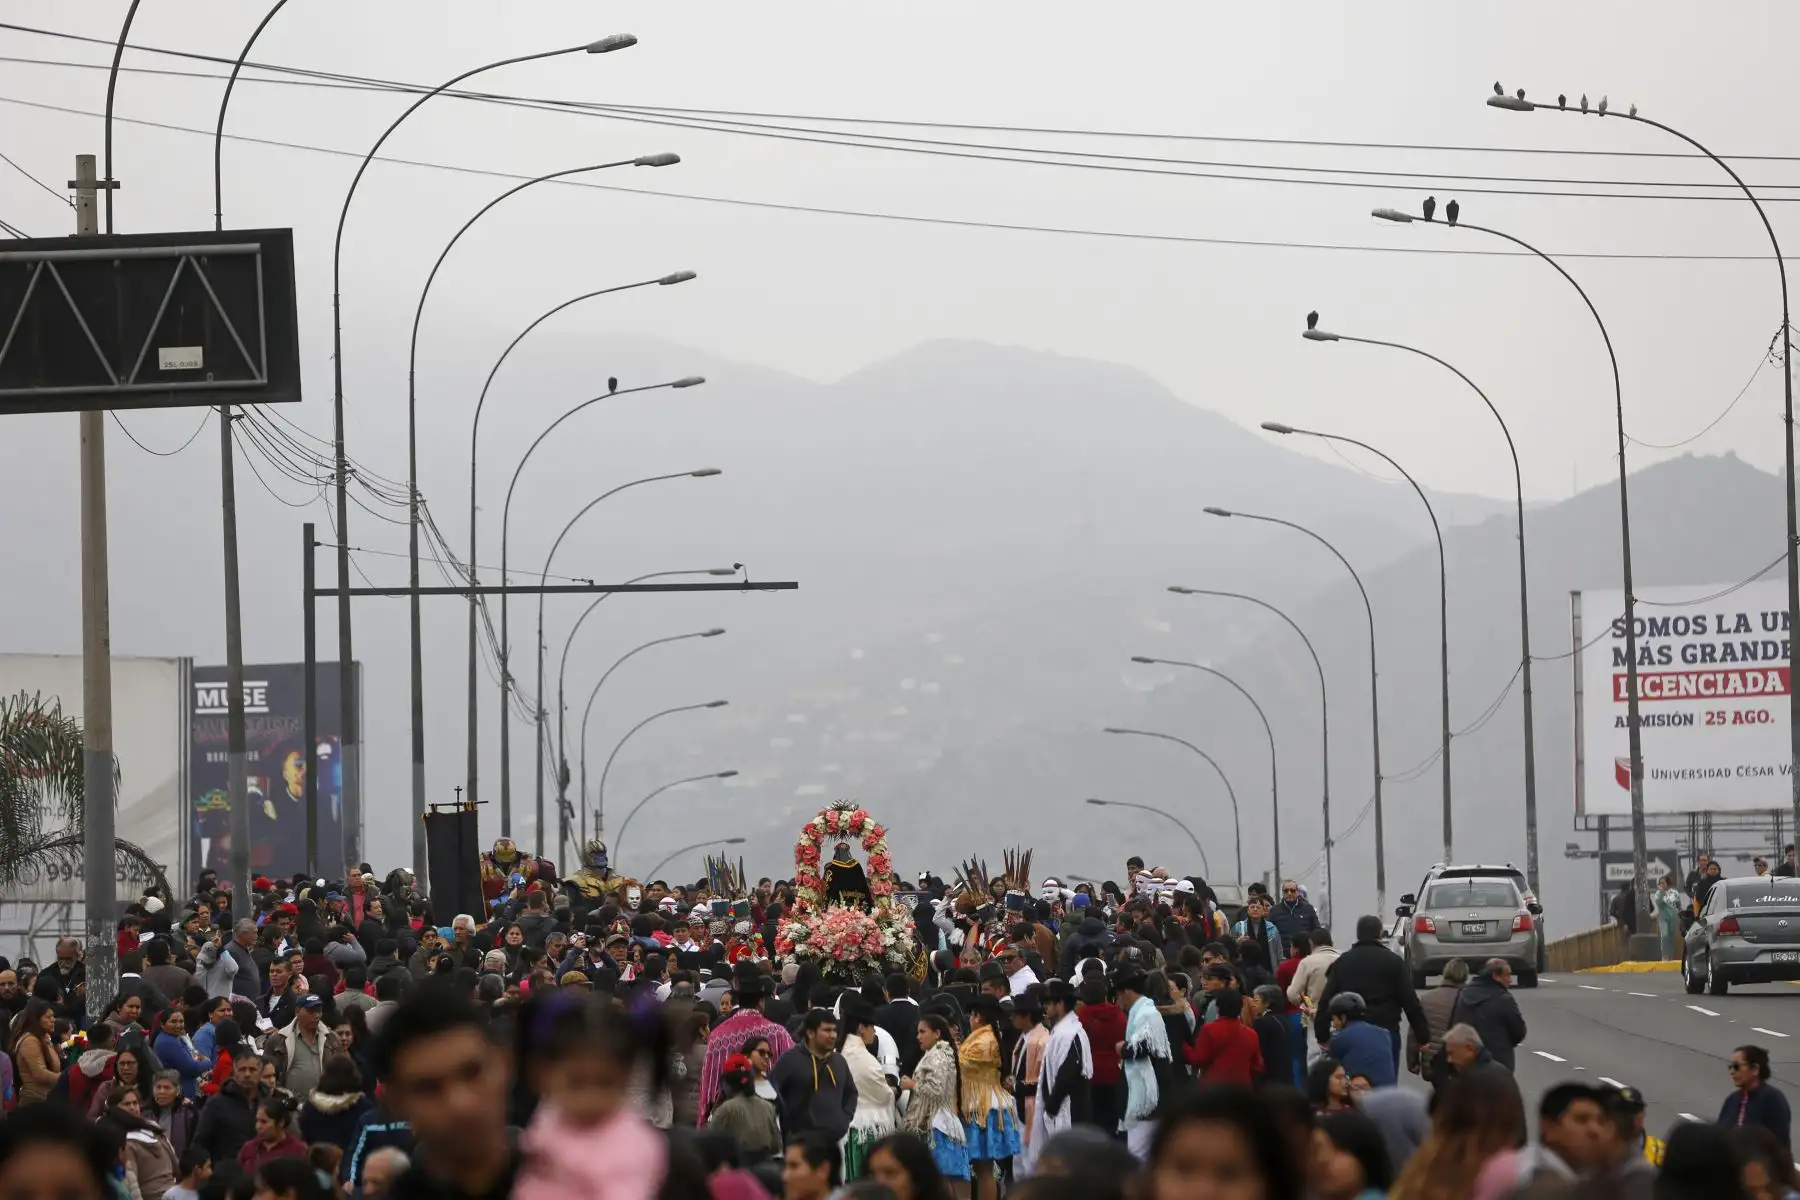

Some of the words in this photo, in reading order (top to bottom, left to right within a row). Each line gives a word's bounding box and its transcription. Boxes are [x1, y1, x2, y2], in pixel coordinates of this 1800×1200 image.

[1611, 614, 1708, 639] SOMOS
[1715, 612, 1752, 635] LA
[1612, 641, 1673, 667] MÁS
[1618, 671, 1785, 699] LICENCIADA
[1705, 711, 1727, 726] 25
[1731, 709, 1775, 726] AGO.
[1651, 767, 1732, 781] UNIVERSIDAD
[1736, 764, 1775, 778] CÉSAR
